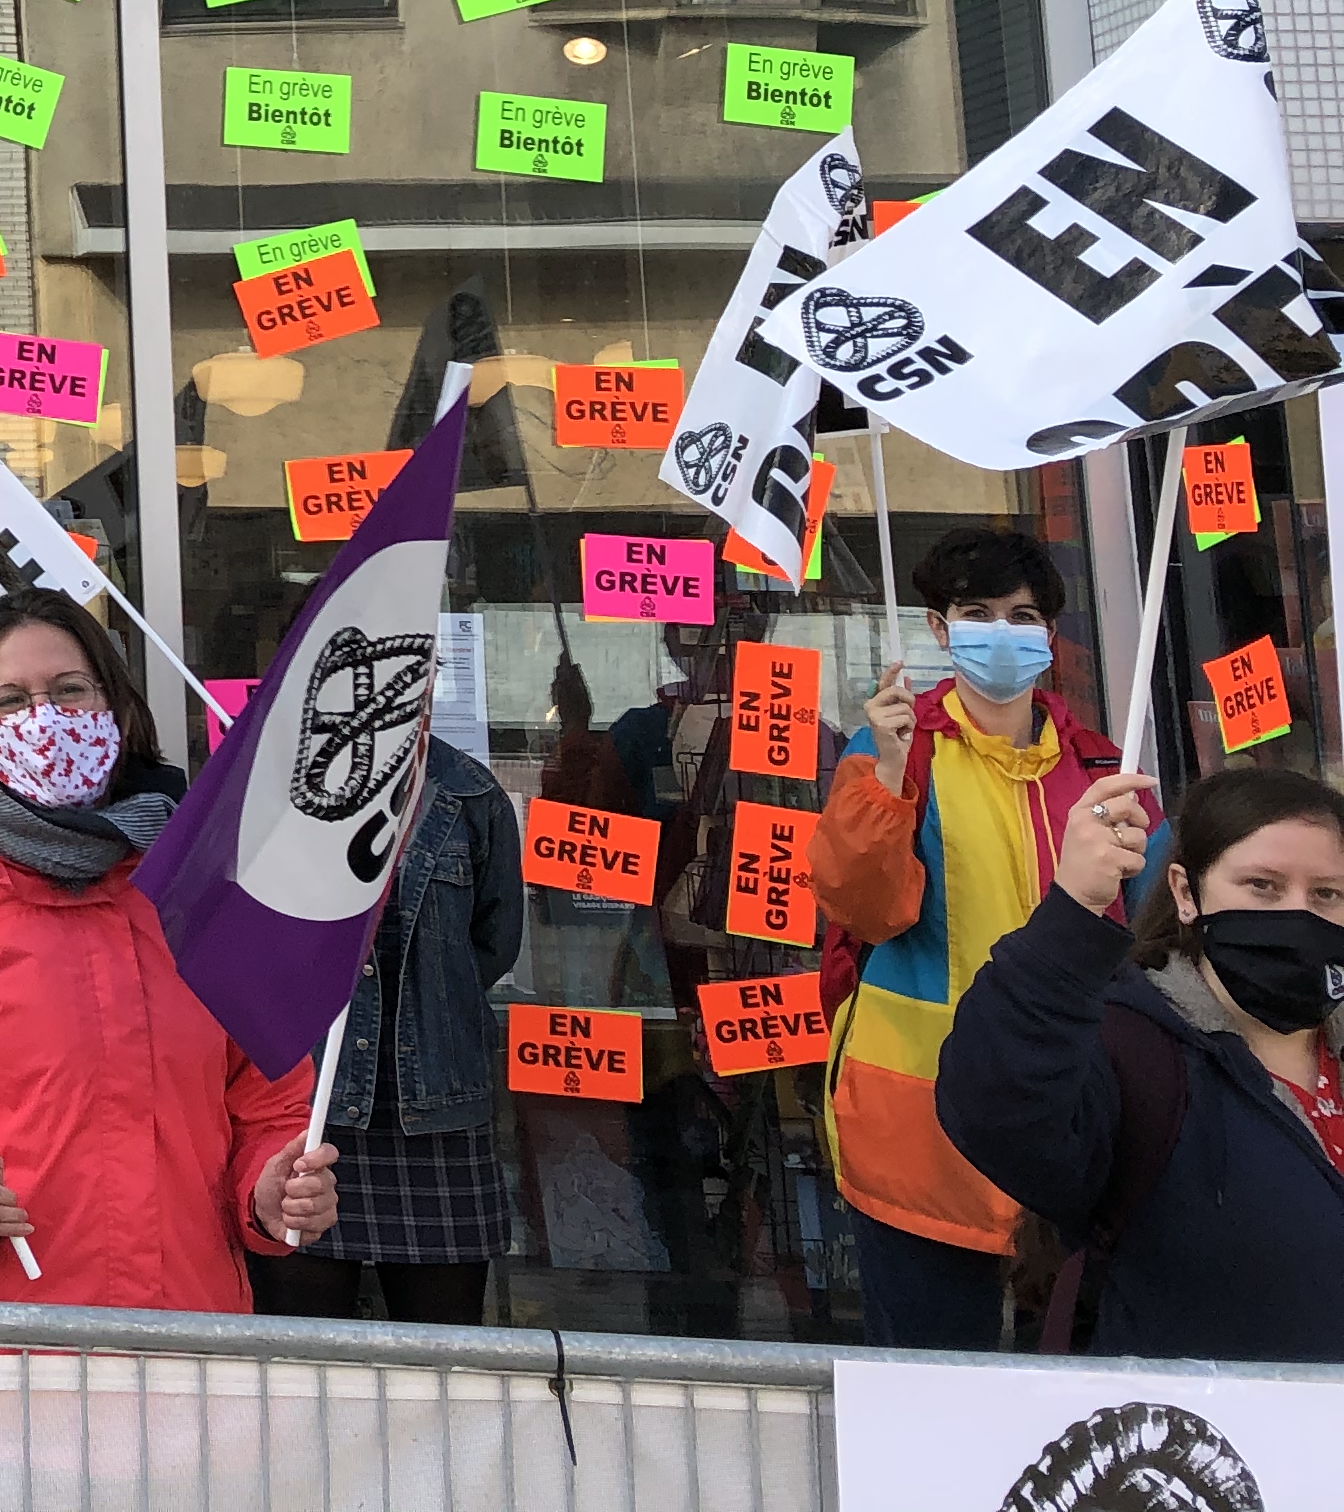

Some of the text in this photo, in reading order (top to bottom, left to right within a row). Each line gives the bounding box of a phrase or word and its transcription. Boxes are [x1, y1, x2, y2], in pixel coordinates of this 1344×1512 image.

[748, 52, 834, 81] En grève
[746, 80, 833, 110] Bientôt
[965, 105, 1260, 327] EN
[17, 340, 57, 365] EN
[595, 371, 634, 392] EN
[857, 334, 975, 403] CSN
[565, 395, 668, 423] GRÈVE
[710, 432, 750, 508] CSN
[1203, 451, 1226, 474] EN
[1191, 481, 1246, 506] GRÈVE
[626, 541, 666, 566] EN
[595, 567, 700, 598] GRÈVE
[737, 690, 761, 733] EN
[764, 661, 793, 767] GRÈVE
[567, 810, 610, 840] EN
[533, 835, 641, 876] GRÈVE
[549, 1013, 594, 1039] EN
[517, 1040, 627, 1074] GRÈVE
